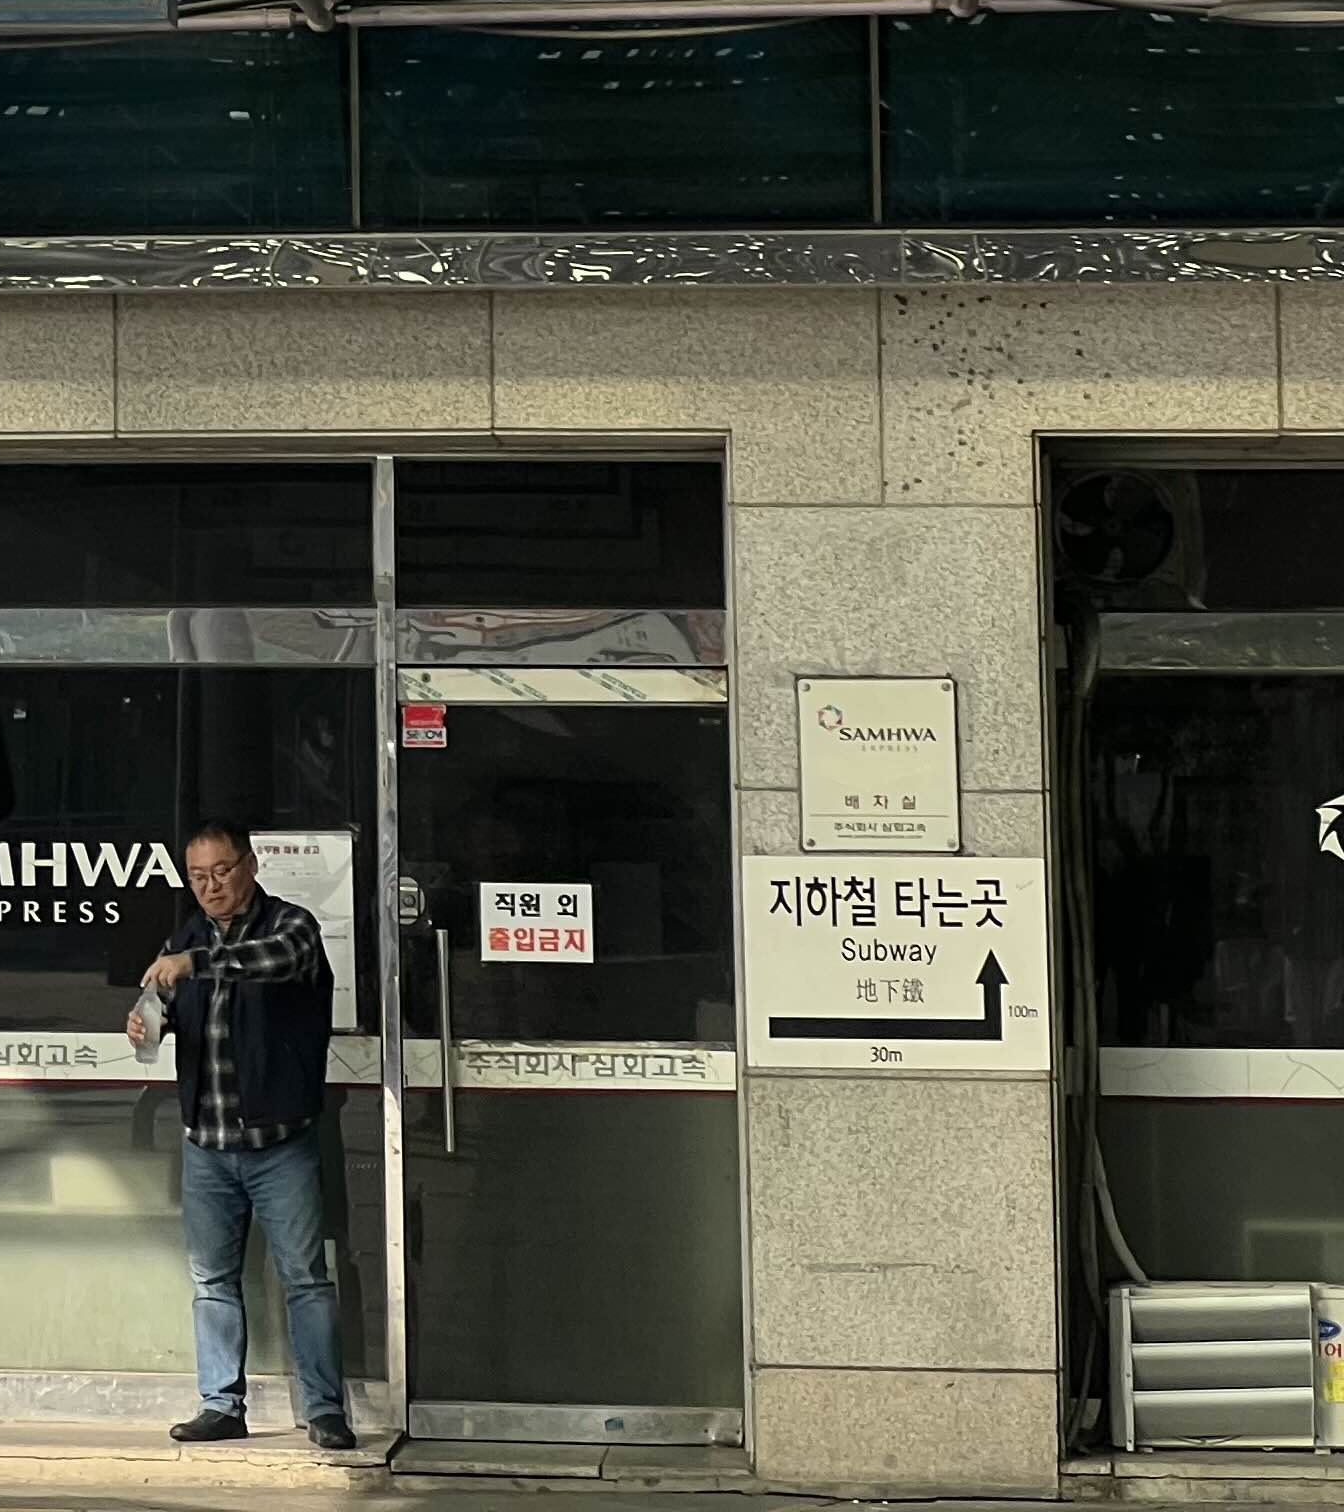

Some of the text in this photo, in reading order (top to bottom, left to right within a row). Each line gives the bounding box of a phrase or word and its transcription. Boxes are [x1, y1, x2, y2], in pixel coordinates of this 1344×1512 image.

[839, 728, 936, 742] SAMHWA
[494, 892, 579, 918] 직원 외
[769, 876, 1007, 927] 지하철 타는곳
[488, 928, 586, 953] 출입금지
[841, 937, 936, 965] Subway
[1008, 1005, 1039, 1018] 100m
[870, 1046, 903, 1063] 30m
